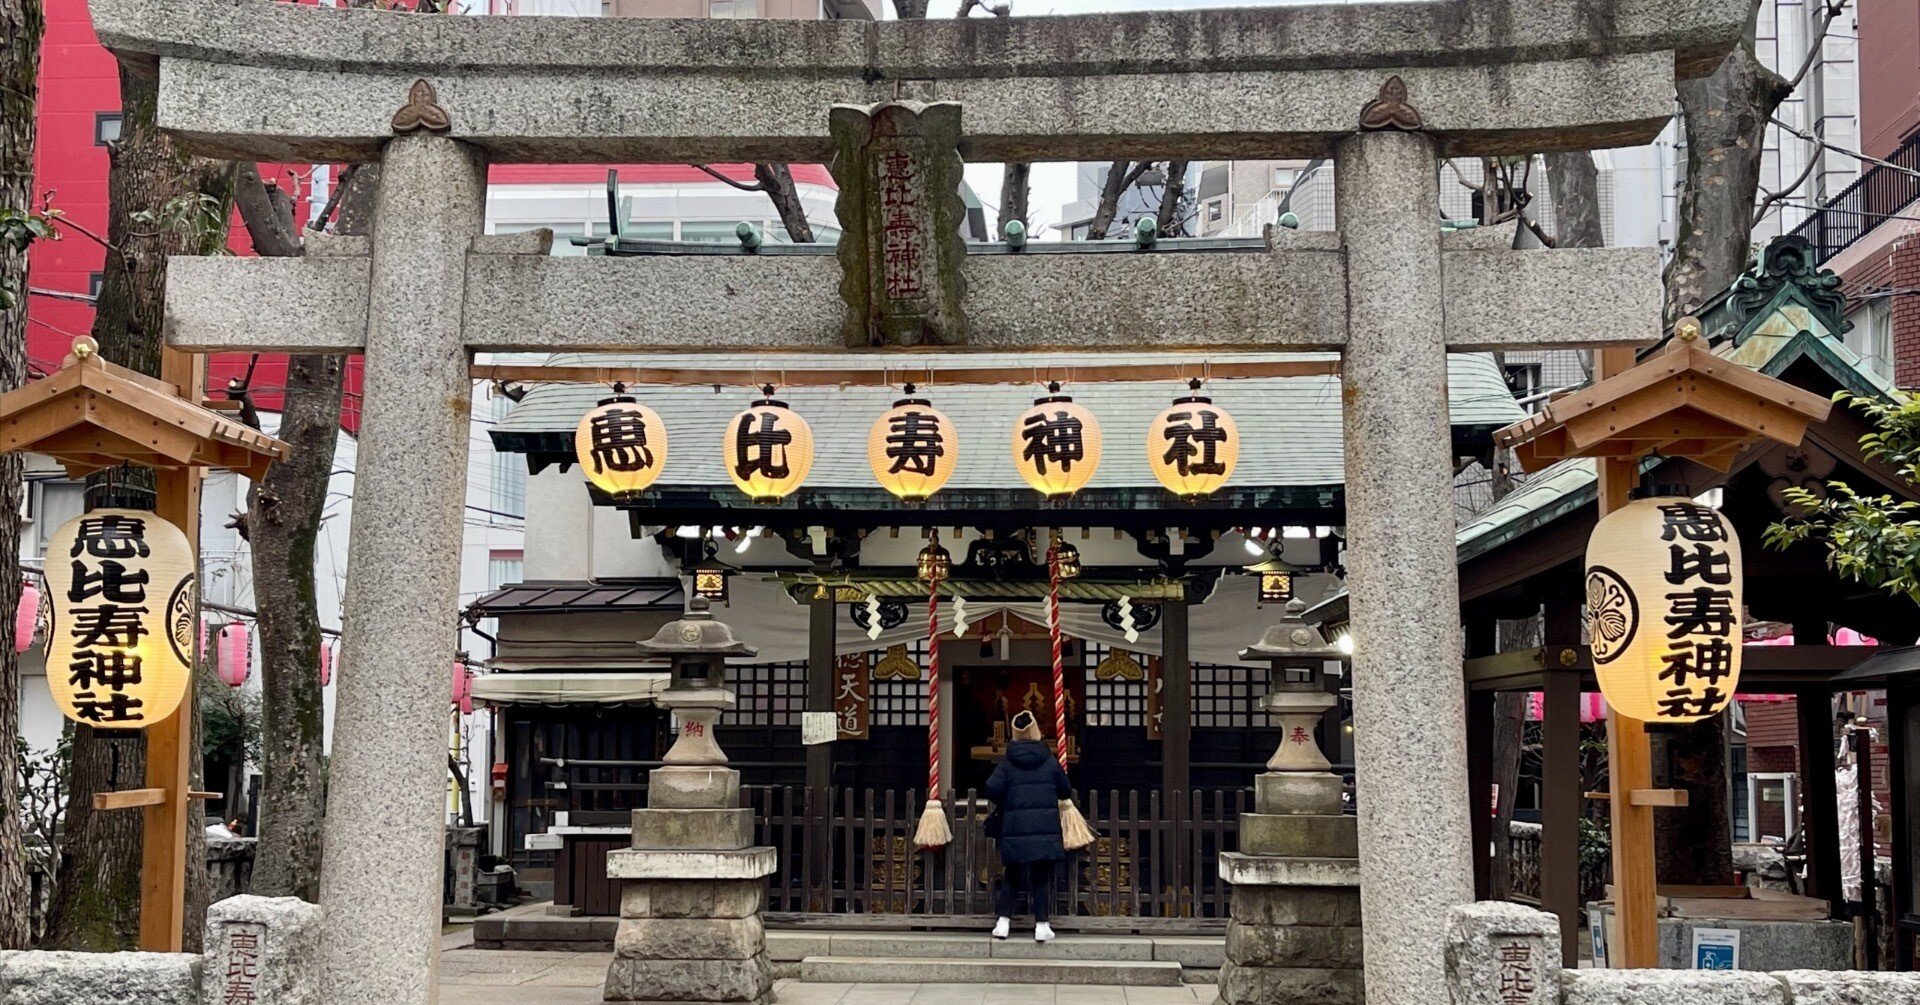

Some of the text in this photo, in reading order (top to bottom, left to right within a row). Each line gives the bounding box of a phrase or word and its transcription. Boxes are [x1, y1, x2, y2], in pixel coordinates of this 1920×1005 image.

[67, 515, 150, 722] 恵比寿神社
[1657, 502, 1736, 717] 恵比寿神社
[684, 720, 704, 737] 納
[1289, 726, 1310, 746] 奉
